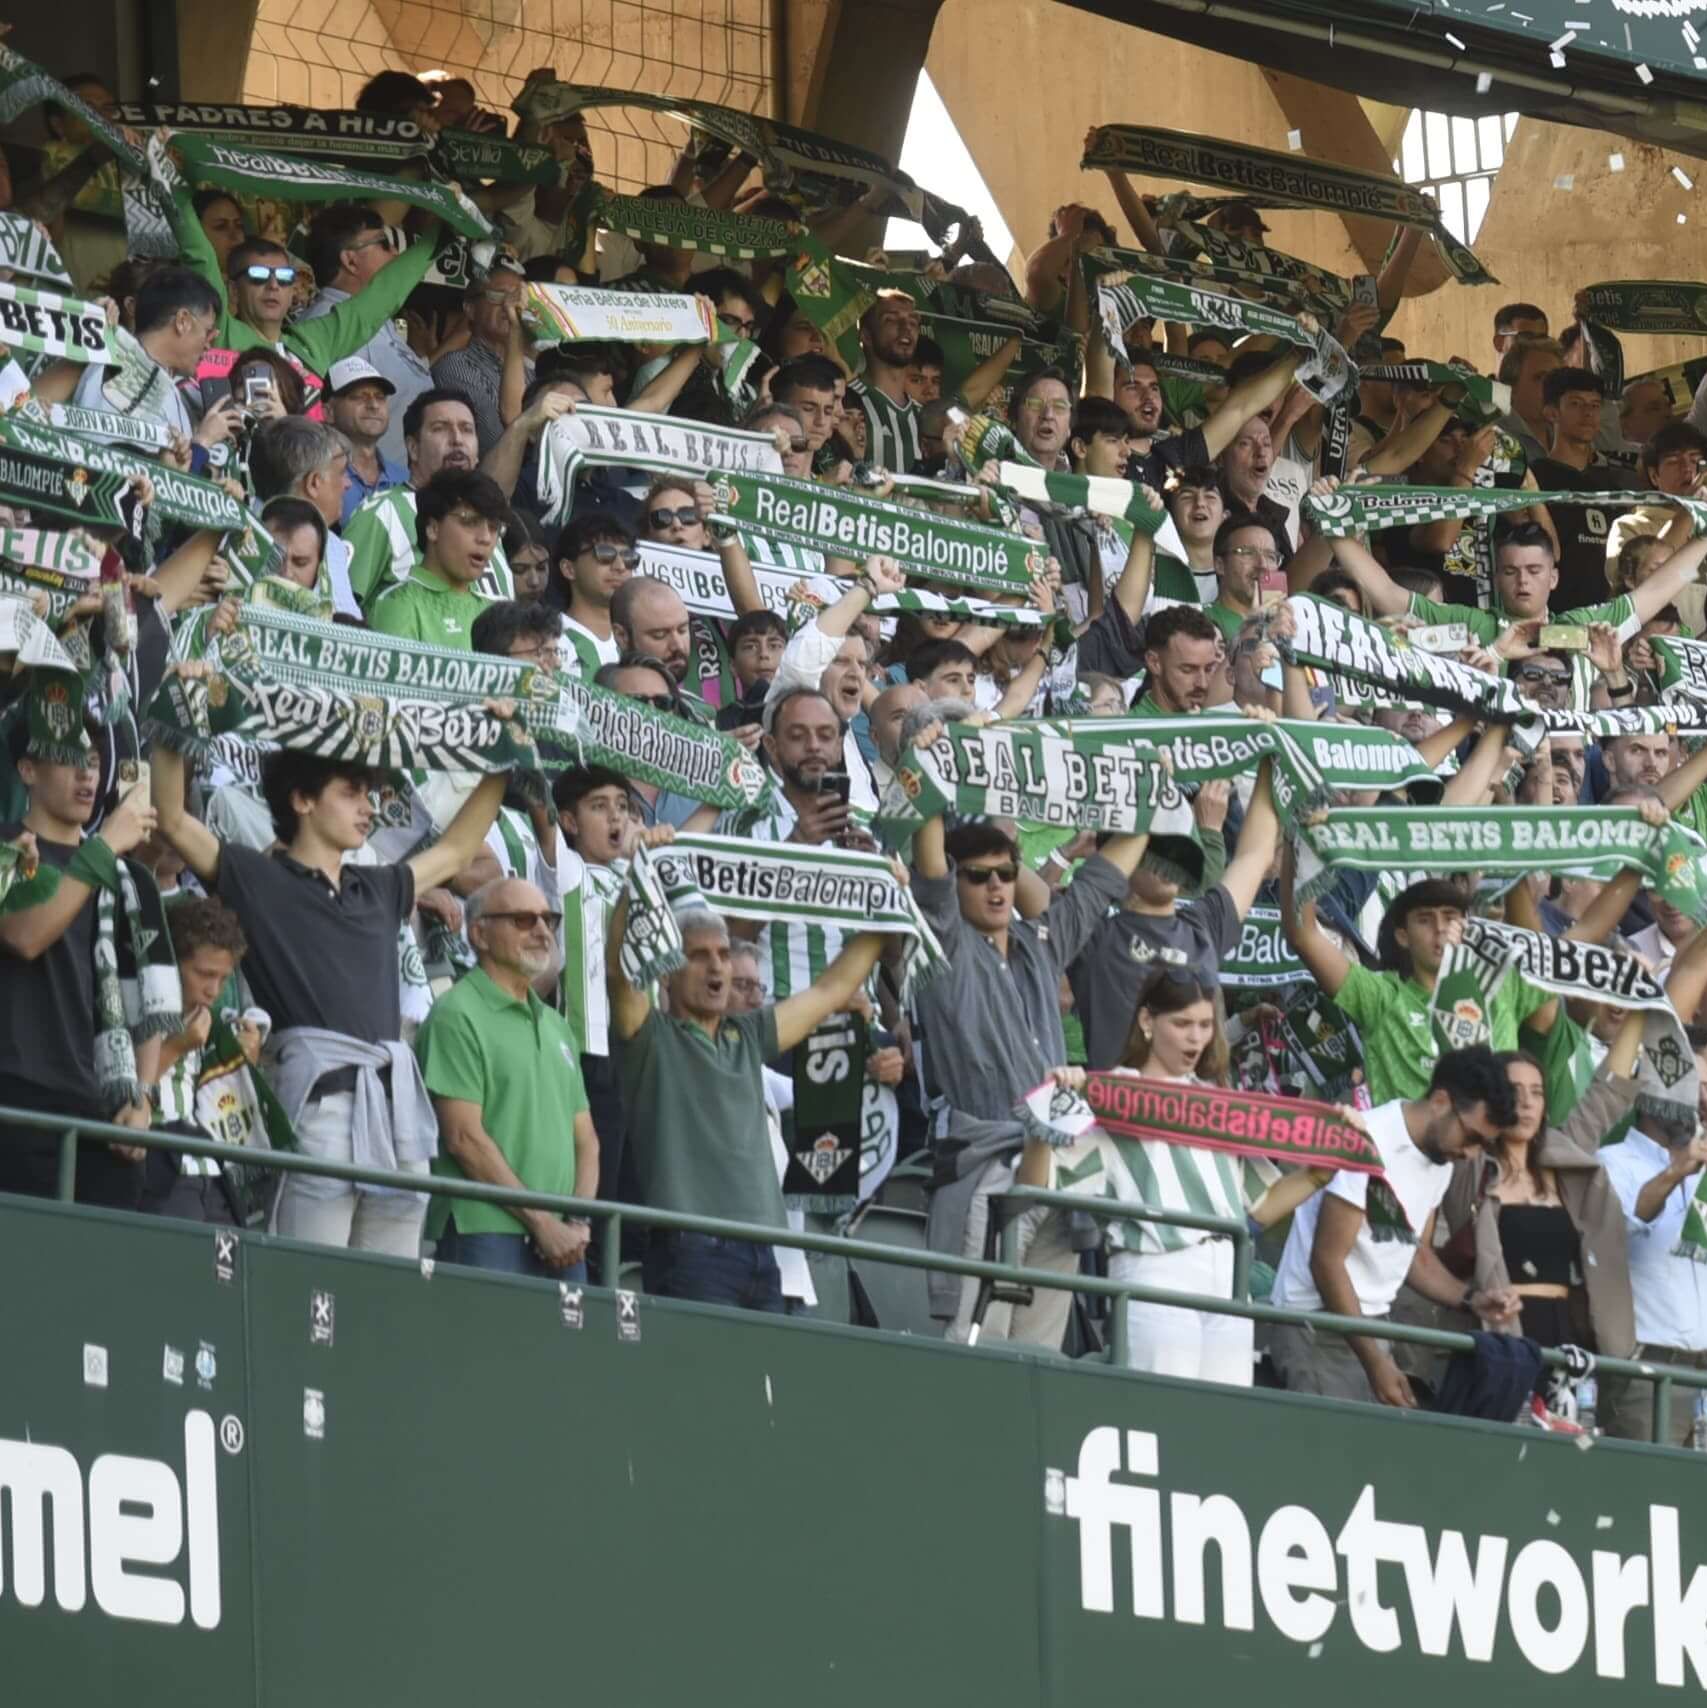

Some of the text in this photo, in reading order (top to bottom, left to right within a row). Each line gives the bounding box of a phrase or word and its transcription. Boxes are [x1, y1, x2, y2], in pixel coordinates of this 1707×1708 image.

[154, 105, 292, 128] PADRES
[303, 114, 328, 131] A
[560, 289, 594, 306] Peña
[634, 293, 651, 308] de
[756, 486, 1009, 575] RealBetisBalompié
[249, 623, 521, 694] REAL BETIS BALOMPIE
[937, 735, 1180, 808] REAL BETIS
[1000, 791, 1123, 830] BALOMPIE
[1310, 821, 1502, 852] REAL BETIS
